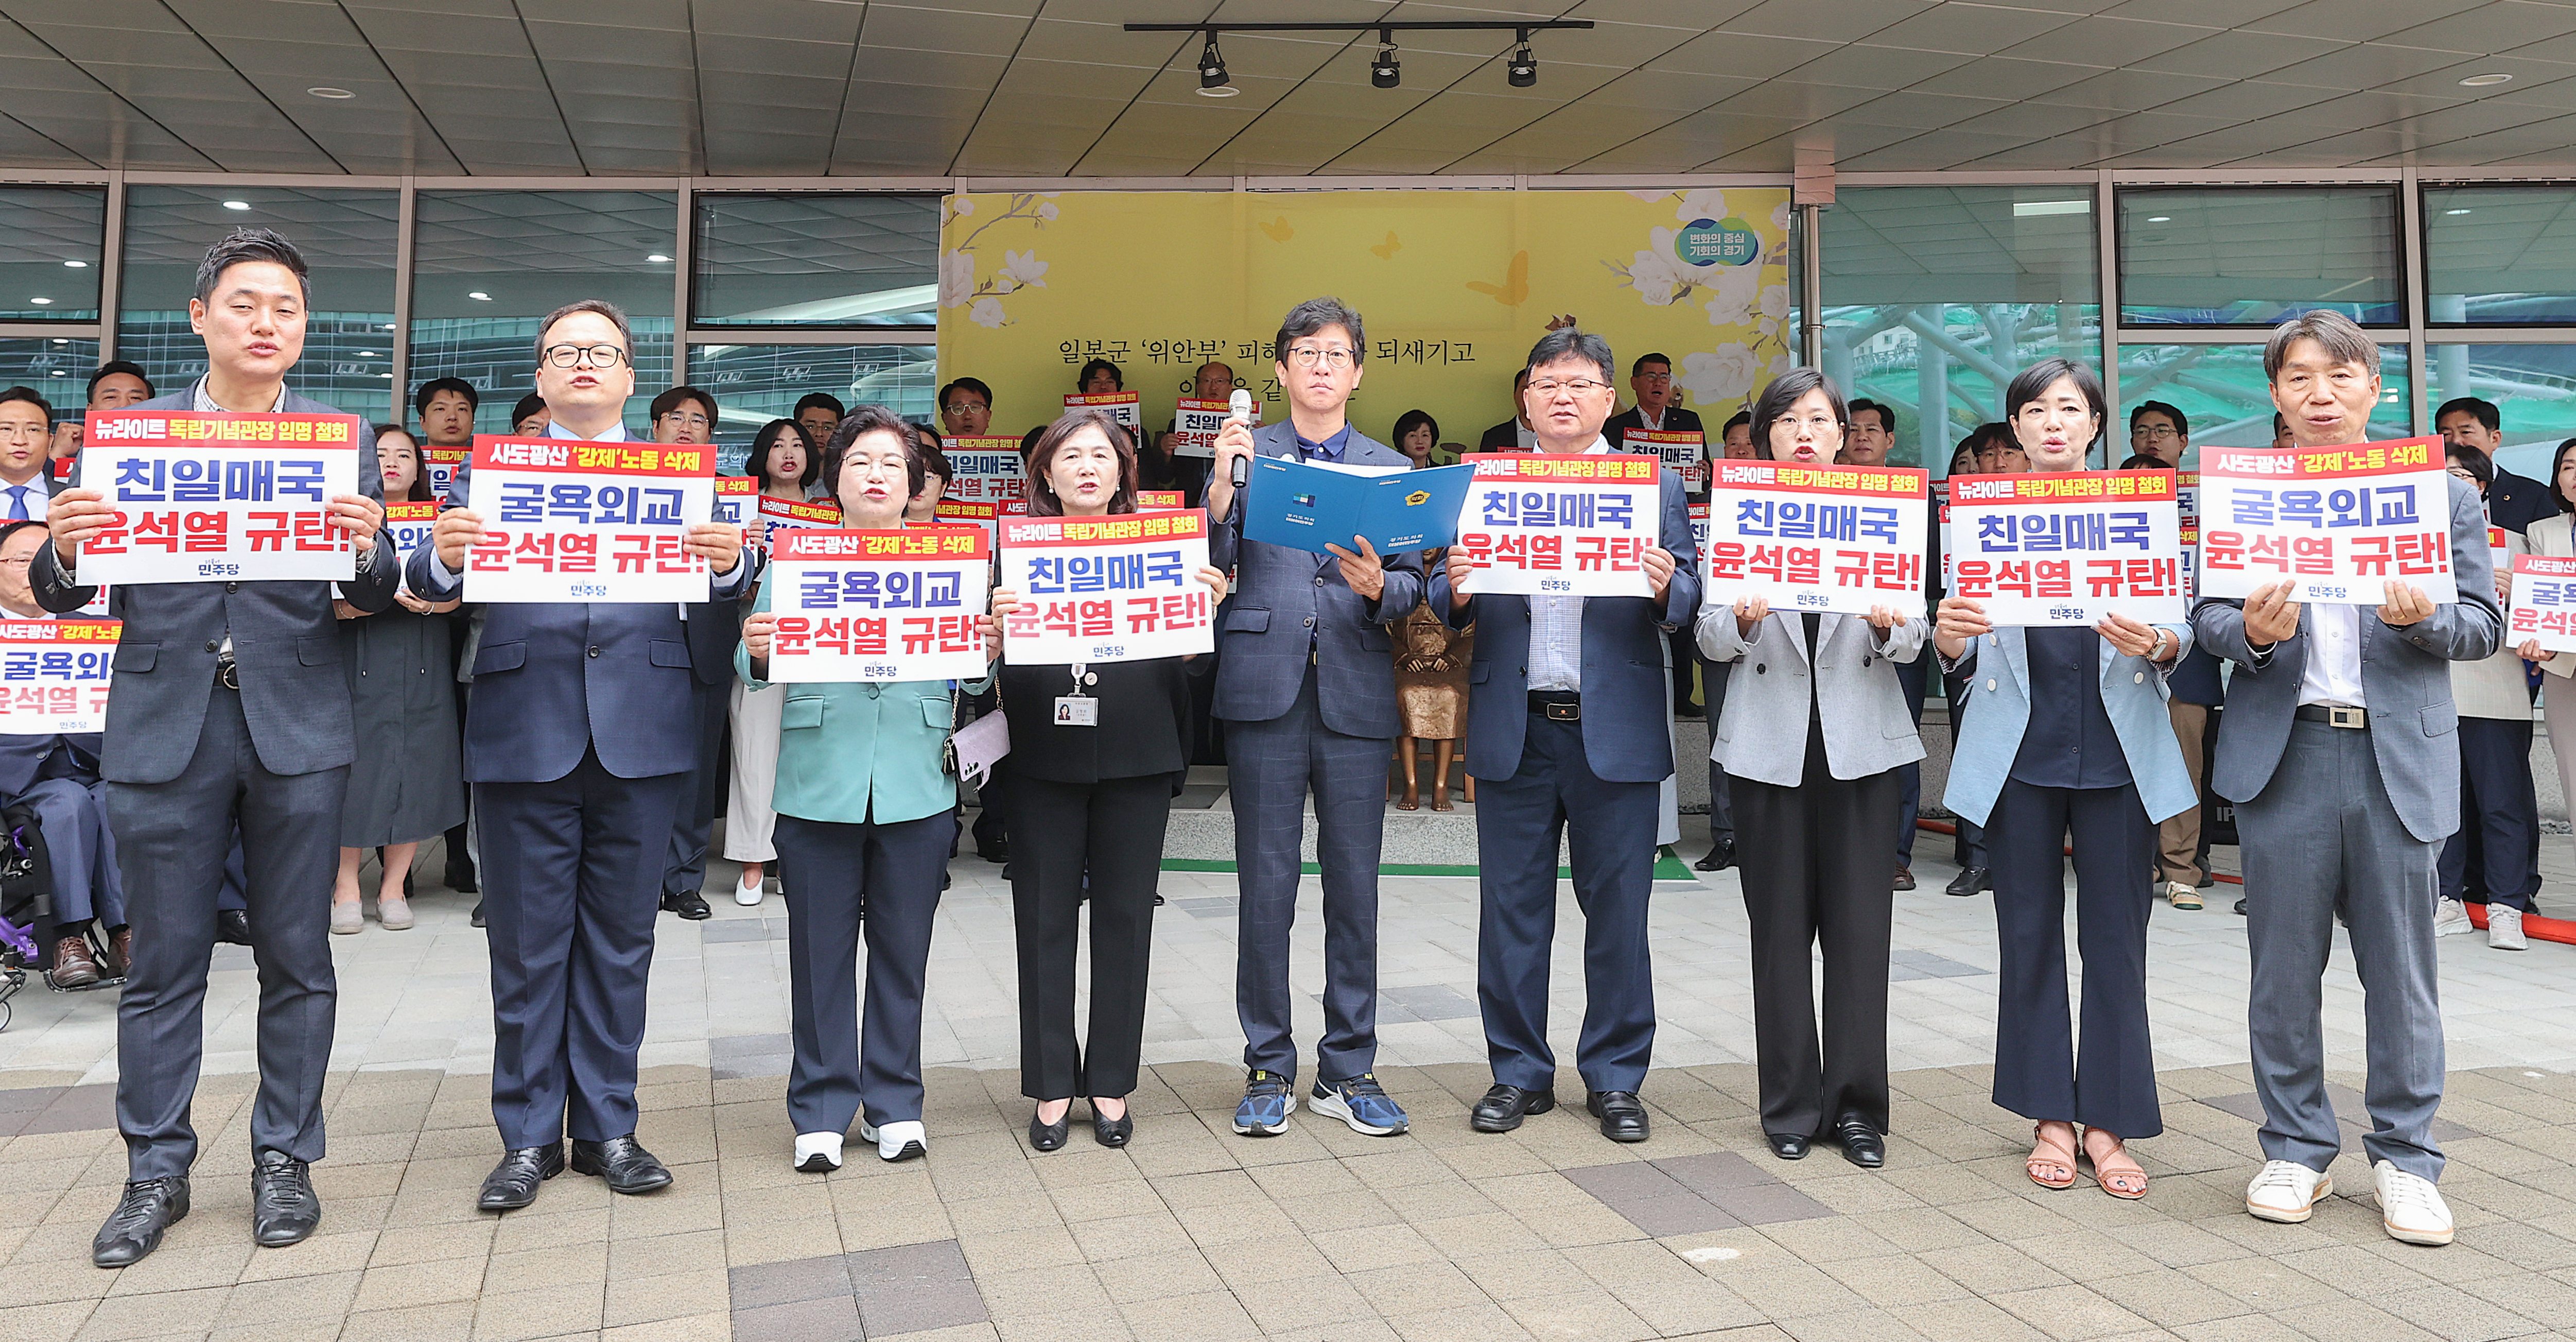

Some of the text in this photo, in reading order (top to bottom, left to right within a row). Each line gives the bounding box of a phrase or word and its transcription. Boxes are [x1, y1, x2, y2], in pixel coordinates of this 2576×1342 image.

[1690, 233, 1745, 244] 변화의 중심
[1690, 246, 1744, 256] 기회의 경기
[1059, 339, 1131, 364] 일본군
[1376, 339, 1475, 365] 되새기고
[1180, 400, 1201, 408] 뉴라이트
[95, 419, 348, 442] 뉴라이트 독립기념관장 임명 철회
[1627, 430, 1648, 439] 뉴라이트
[958, 439, 999, 448] 독립기념관장
[1000, 439, 1013, 448] 임명
[1015, 439, 1022, 448] 철
[490, 443, 568, 467] 사도광산
[664, 451, 700, 471] 삭제
[2217, 454, 2295, 474] 사도광산
[2390, 444, 2428, 465] 삭제
[115, 458, 325, 502] 친일매국
[1519, 460, 1595, 477] 독립기념관장
[1597, 461, 1623, 477] 임명
[1625, 462, 1651, 478] 철회
[1721, 466, 1919, 493] 뉴라이트 독립기념관장 임명 철회
[728, 481, 749, 492] 삭제
[988, 478, 1028, 496] 규탄
[1958, 476, 2167, 500] 뉴라이트 독립기념관장 임명 철회
[500, 483, 684, 525] 굴욕외교
[762, 500, 790, 514] 뉴라이트
[790, 505, 837, 521] 독립기념관장
[962, 506, 976, 515] 임명
[978, 507, 992, 516] 철회
[1006, 503, 1027, 512] 사도
[1157, 495, 1176, 505] 삭제
[1483, 491, 1633, 529] 친일매국
[2232, 485, 2419, 528] 굴욕외교
[83, 511, 228, 555] 윤석열
[246, 511, 350, 552] 규탄!
[1008, 515, 1198, 541] 뉴라이트 독립기념관장 임명 철회
[1737, 500, 1899, 544] 친일매국
[1979, 512, 2149, 552] 친일매국
[789, 536, 859, 554] 사도광산
[943, 536, 974, 554] 삭제
[2180, 531, 2198, 542] 삭제
[471, 532, 598, 573] 윤석열
[1462, 534, 1562, 570] 윤석열
[2206, 530, 2334, 575] 윤석열
[2351, 532, 2448, 576] 규탄!
[198, 564, 239, 576] 민주당
[1029, 550, 1183, 593] 친일매국
[1712, 542, 1821, 584] 윤석열
[1834, 550, 1920, 591] 규탄!
[2526, 559, 2576, 573] 사도광산
[1541, 580, 1571, 591] 민주당
[1957, 560, 2072, 598] 윤석열
[2086, 558, 2177, 597] 규탄!
[571, 584, 606, 596] 민주당
[800, 572, 961, 609] 굴욕외교
[1797, 594, 1829, 606] 민주당
[2309, 586, 2346, 598] 민주당
[1007, 592, 1206, 638] 윤석열 규탄!
[2050, 609, 2084, 620] 민주당
[0, 624, 57, 640] 사도광산
[775, 614, 982, 655] 윤석열 규탄!
[1093, 646, 1124, 657] 민주당
[4, 652, 114, 680] 굴욕외
[865, 666, 897, 676] 민주당
